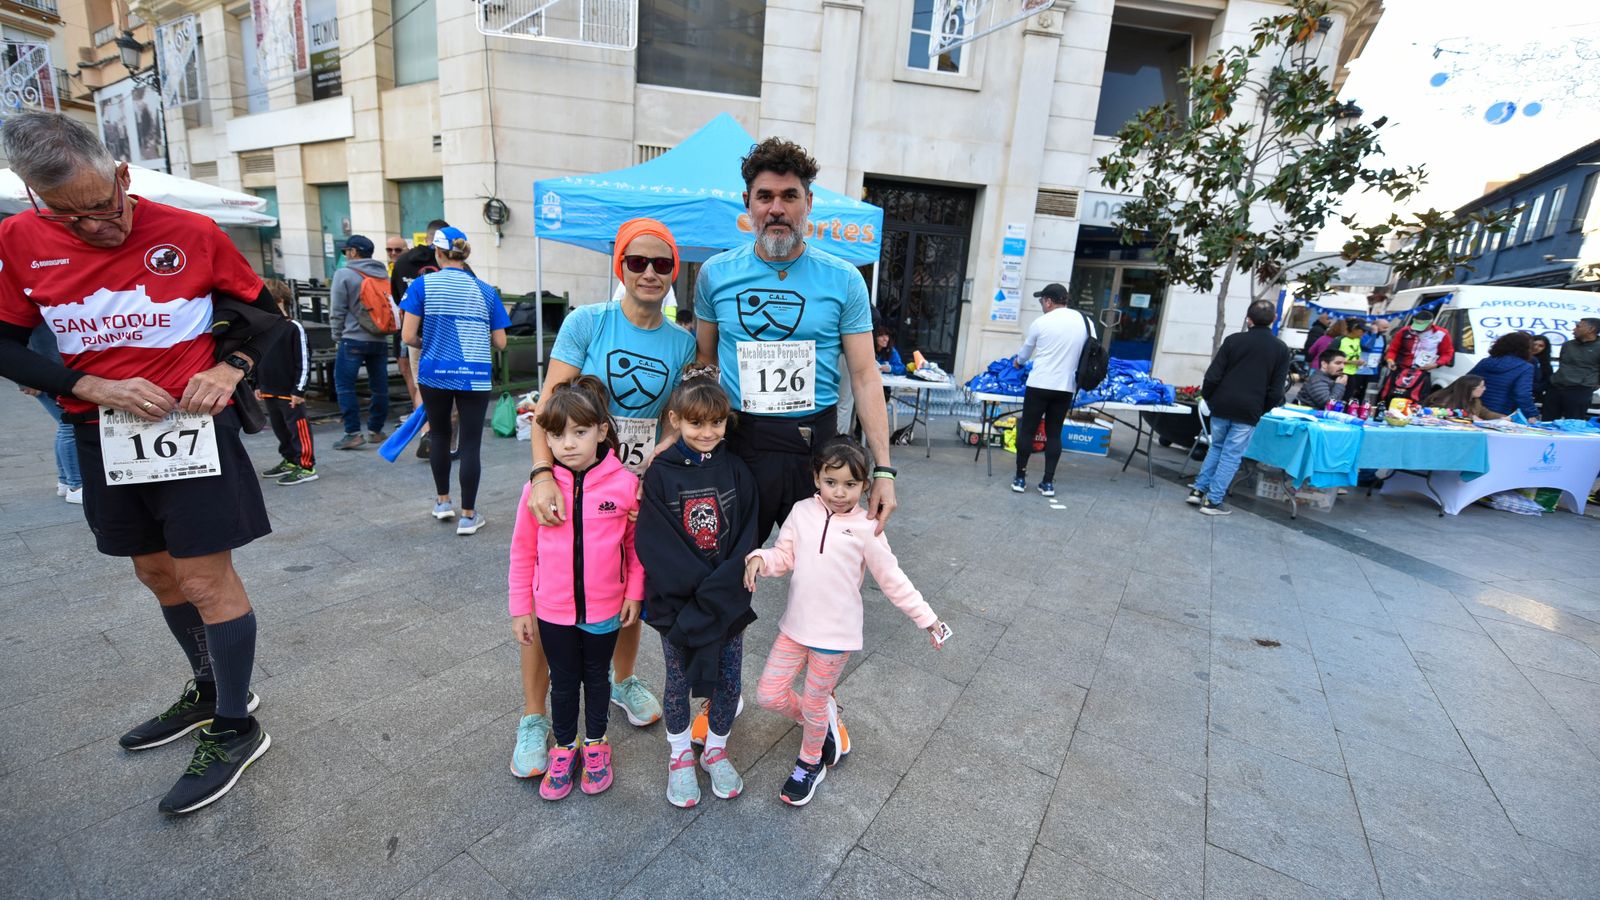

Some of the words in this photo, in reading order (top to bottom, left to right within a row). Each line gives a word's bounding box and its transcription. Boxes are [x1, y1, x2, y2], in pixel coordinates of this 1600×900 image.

[1480, 300, 1577, 311] APROPADIS
[53, 317, 98, 334] SAN
[1480, 316, 1581, 332] GUAR
[756, 367, 806, 392] 126
[128, 429, 200, 461] 167
[1073, 433, 1094, 443] ROLY
[618, 442, 644, 466] 05
